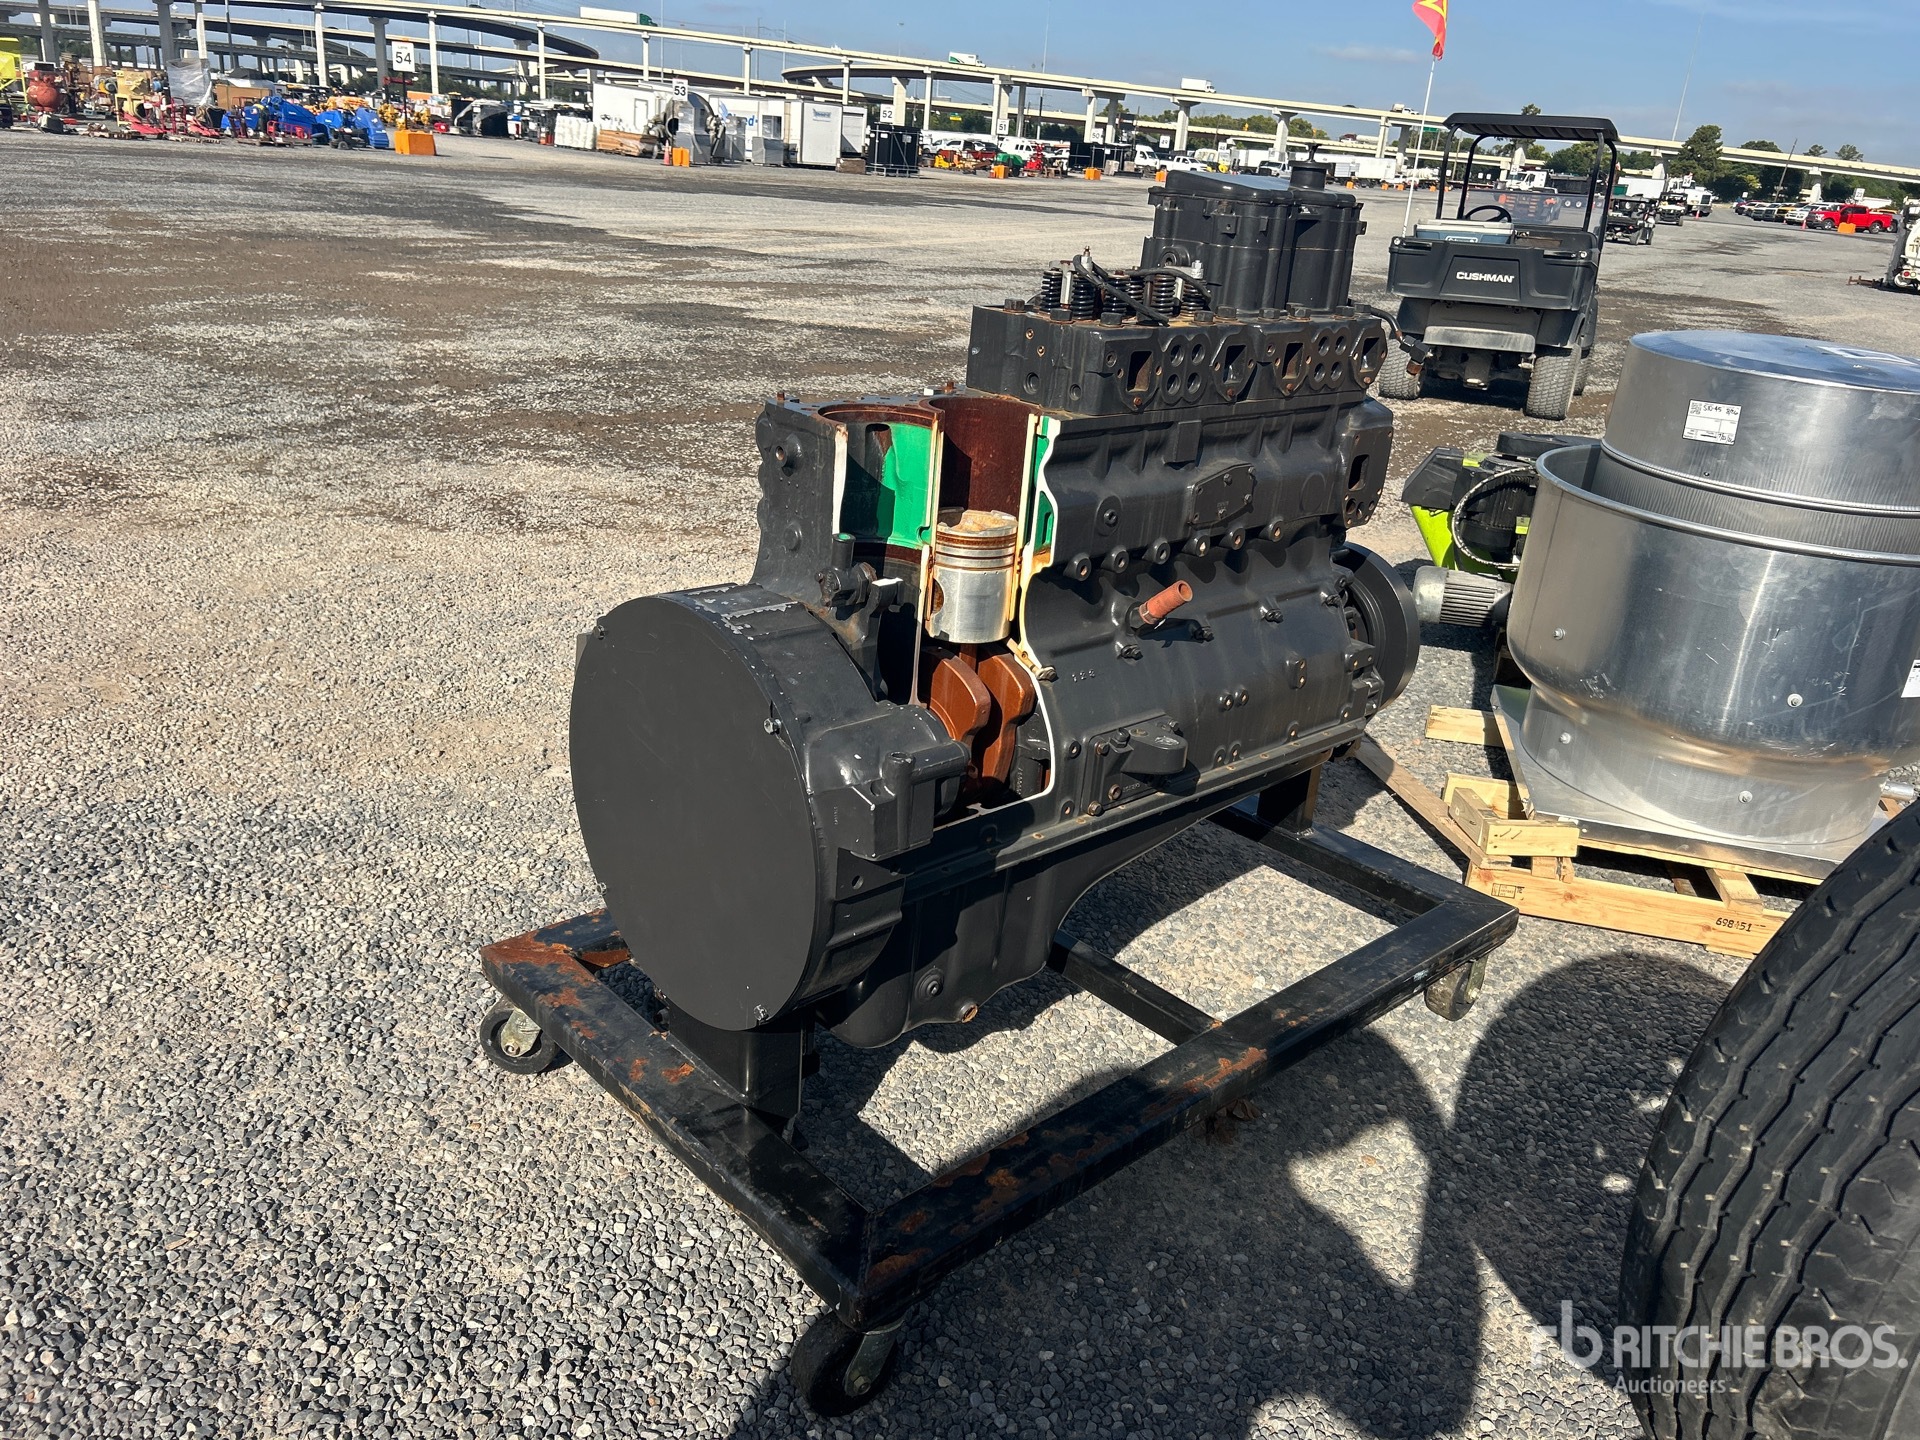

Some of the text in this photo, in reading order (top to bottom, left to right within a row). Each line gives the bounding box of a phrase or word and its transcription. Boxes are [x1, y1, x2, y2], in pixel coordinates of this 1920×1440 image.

[395, 52, 411, 64] 54
[674, 86, 686, 96] 53
[882, 110, 893, 119] 52
[999, 123, 1007, 131] 51
[1456, 271, 1514, 283] CUSHMAN
